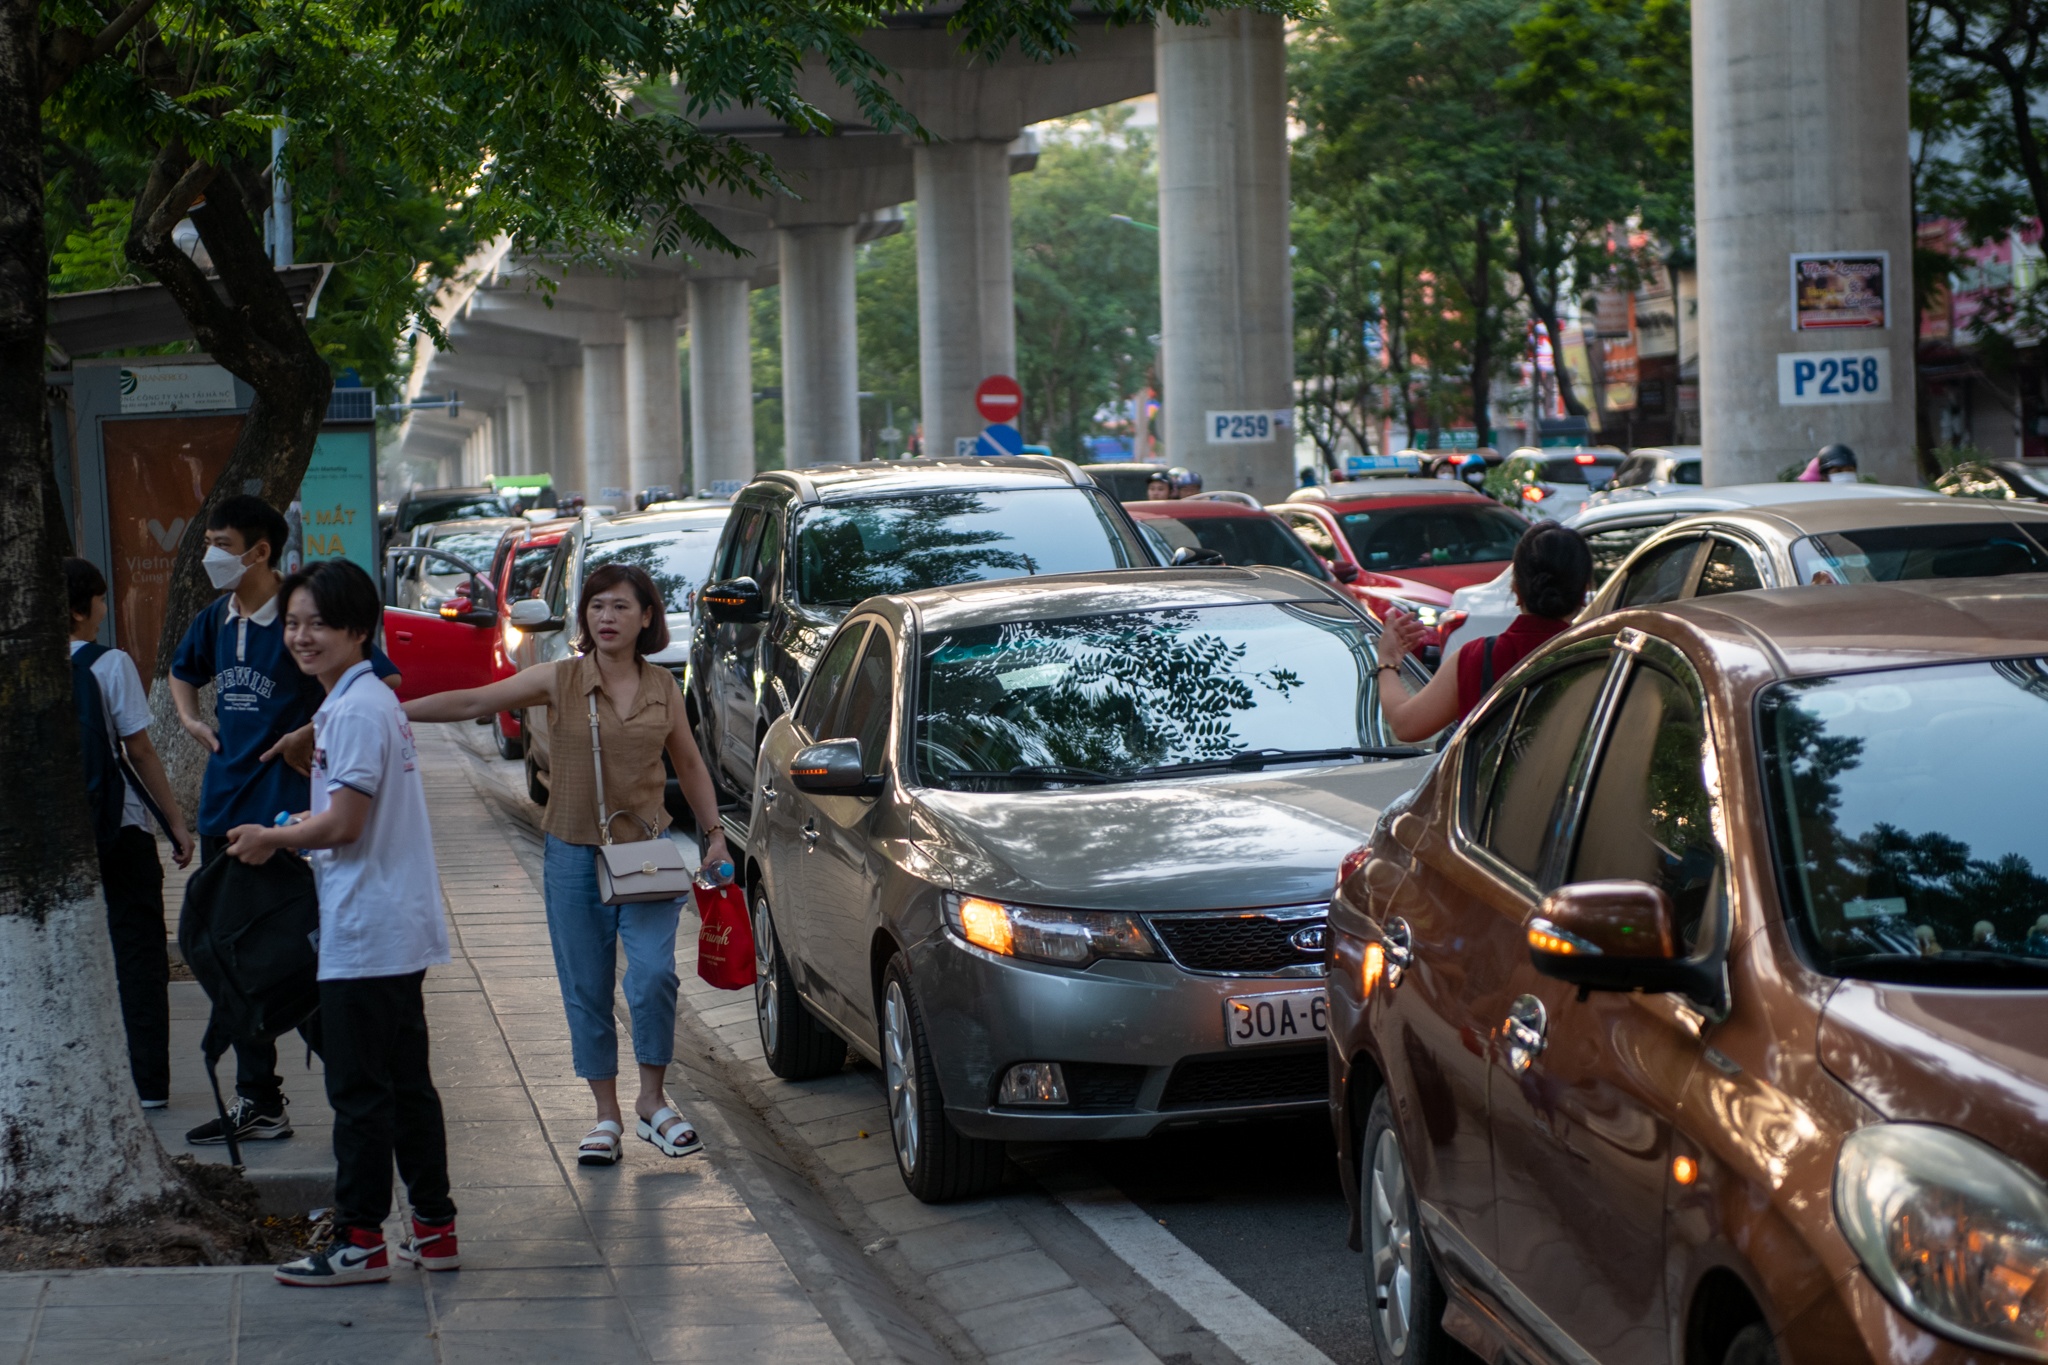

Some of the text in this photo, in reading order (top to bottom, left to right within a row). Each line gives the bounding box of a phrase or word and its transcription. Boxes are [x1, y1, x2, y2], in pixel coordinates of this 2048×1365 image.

[1793, 356, 1879, 396] P258
[1215, 415, 1268, 437] P259
[1300, 929, 1325, 948] KI
[1234, 997, 1326, 1038] 30A-6
